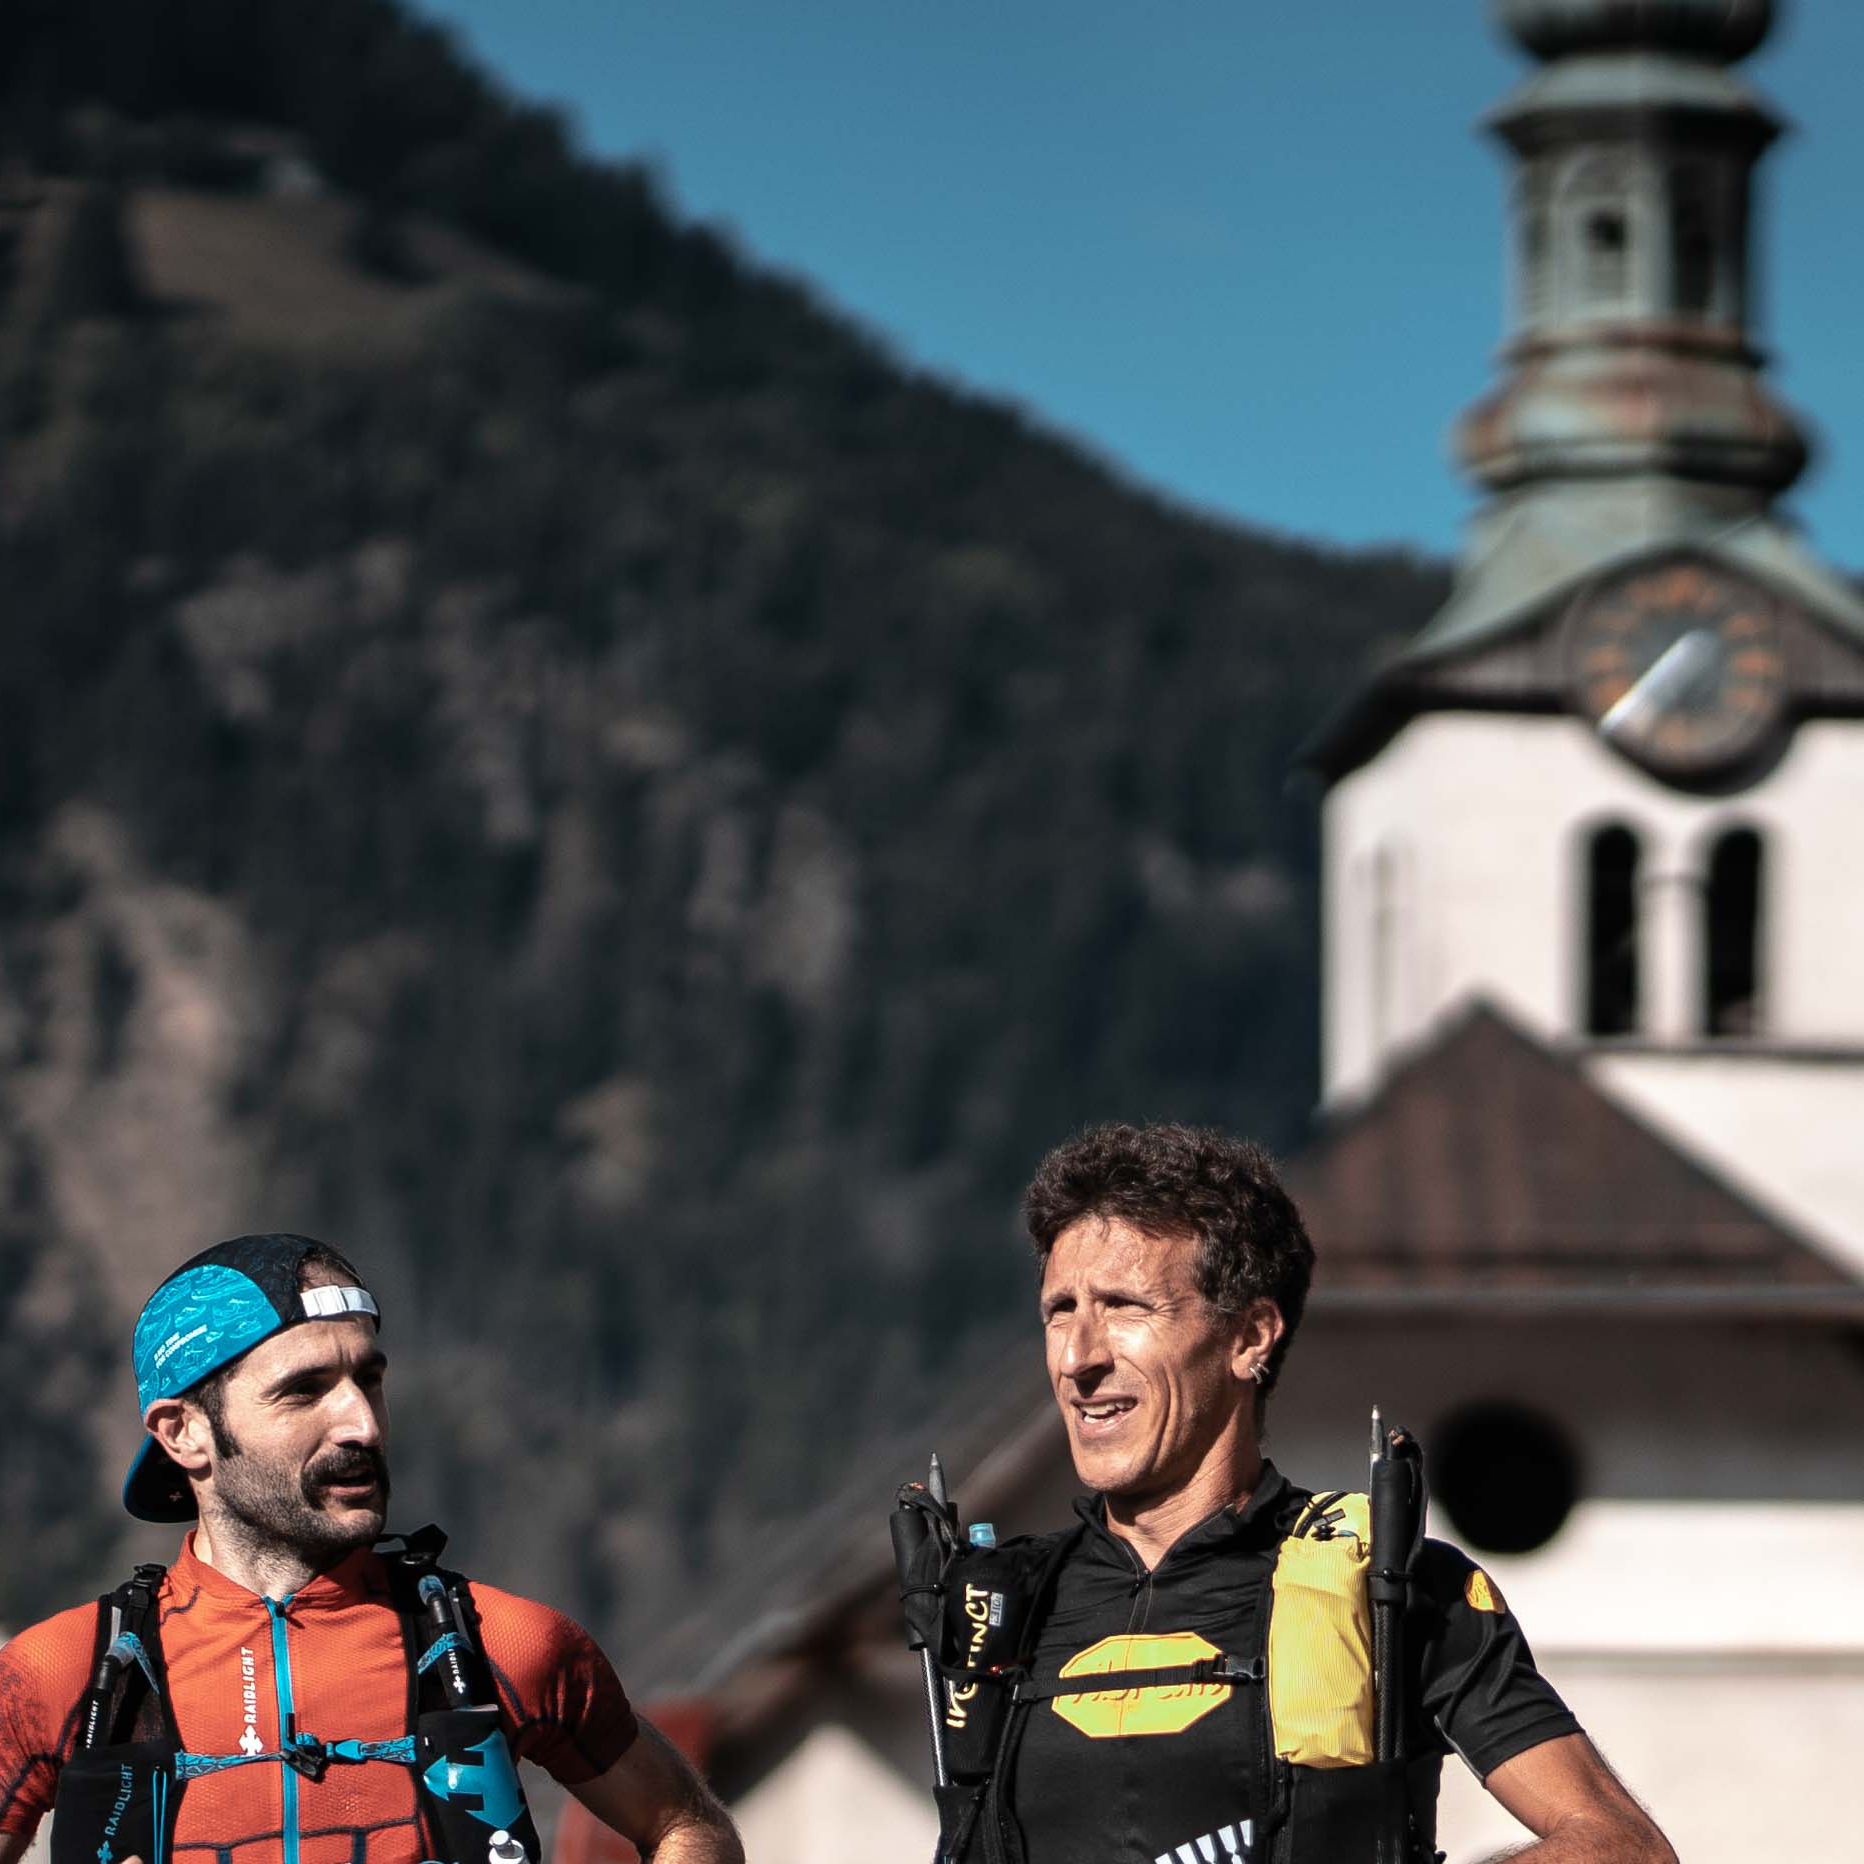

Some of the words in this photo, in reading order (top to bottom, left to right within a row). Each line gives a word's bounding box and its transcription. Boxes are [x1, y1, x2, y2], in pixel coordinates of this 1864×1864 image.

[86, 1700, 100, 1742] RAIDLIGHT
[240, 1646, 258, 1724] RAIDLIGHT
[104, 1763, 134, 1837] RAIDLIGHT
